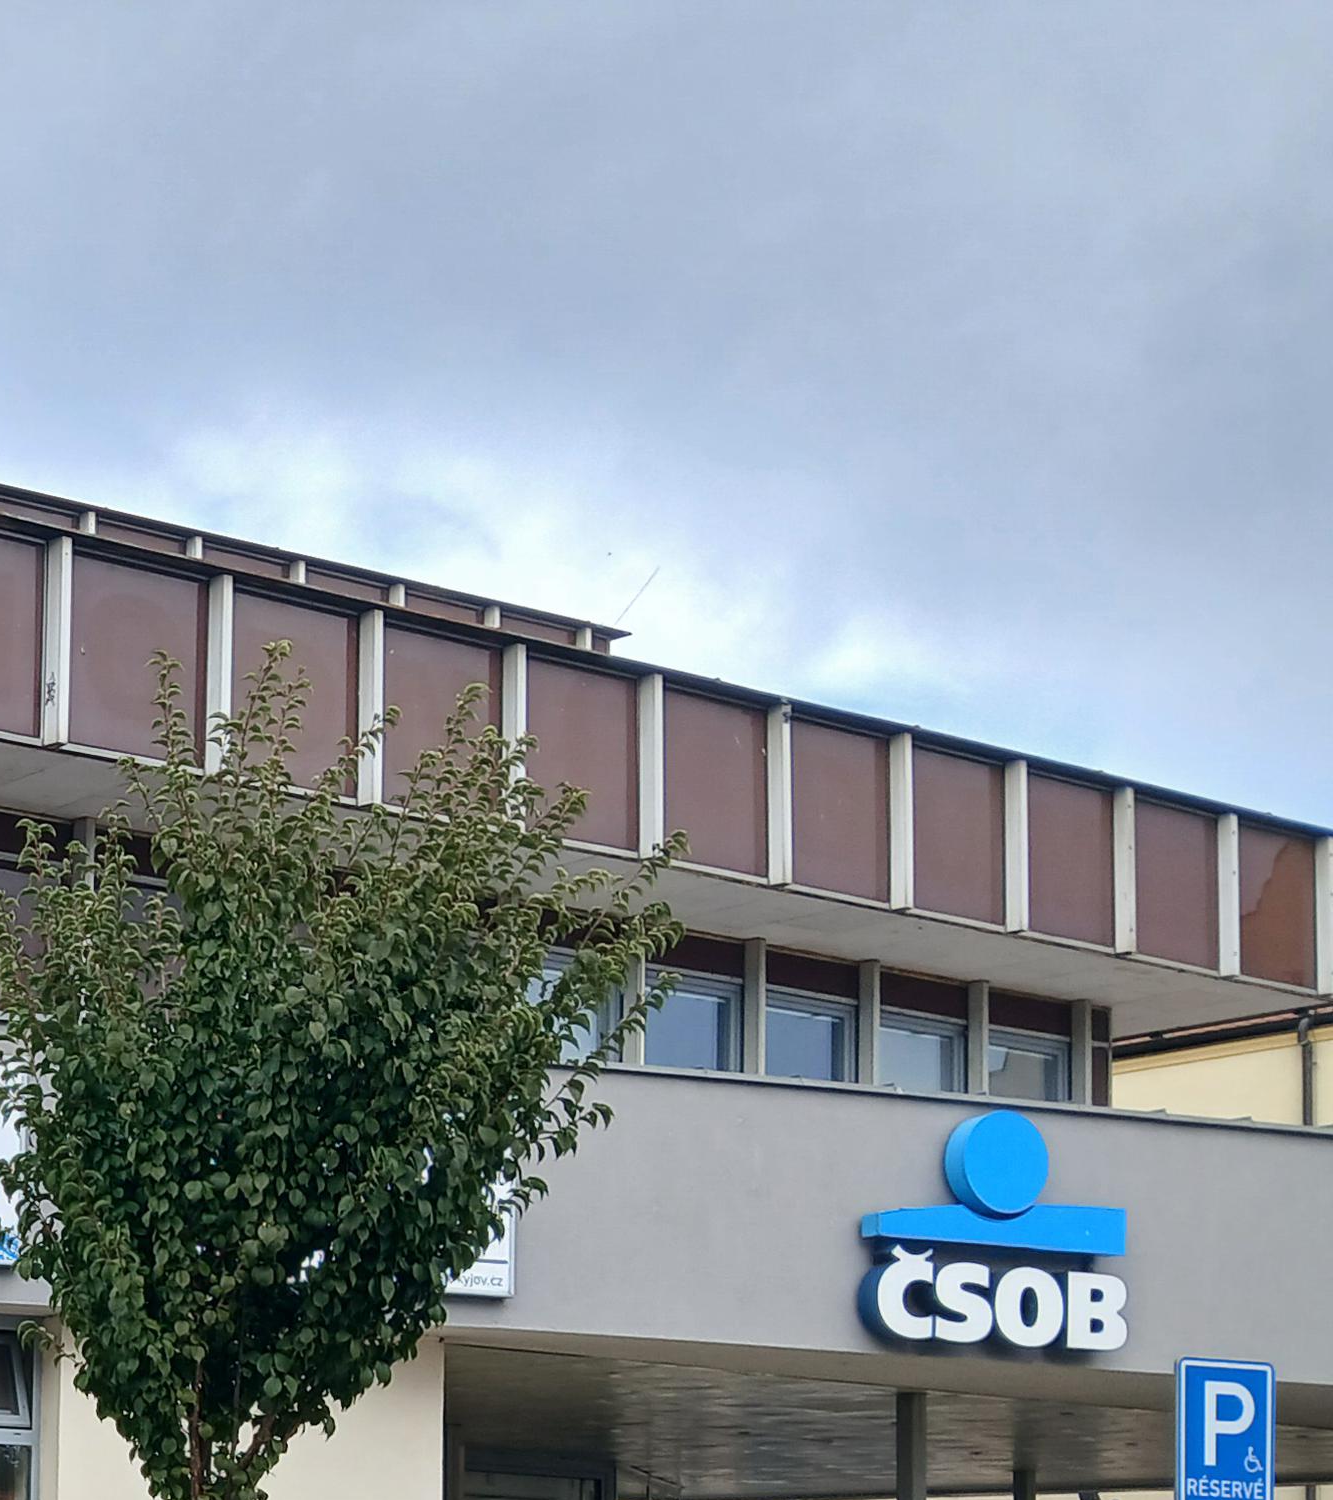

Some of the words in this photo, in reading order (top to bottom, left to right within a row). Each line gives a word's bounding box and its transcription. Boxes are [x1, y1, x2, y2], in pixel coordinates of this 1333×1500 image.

[457, 1272, 503, 1288] yjov.cz
[876, 1244, 1129, 1352] ČSOB
[1204, 1381, 1255, 1466] P
[1186, 1474, 1264, 1500] RÉSERVÉ
